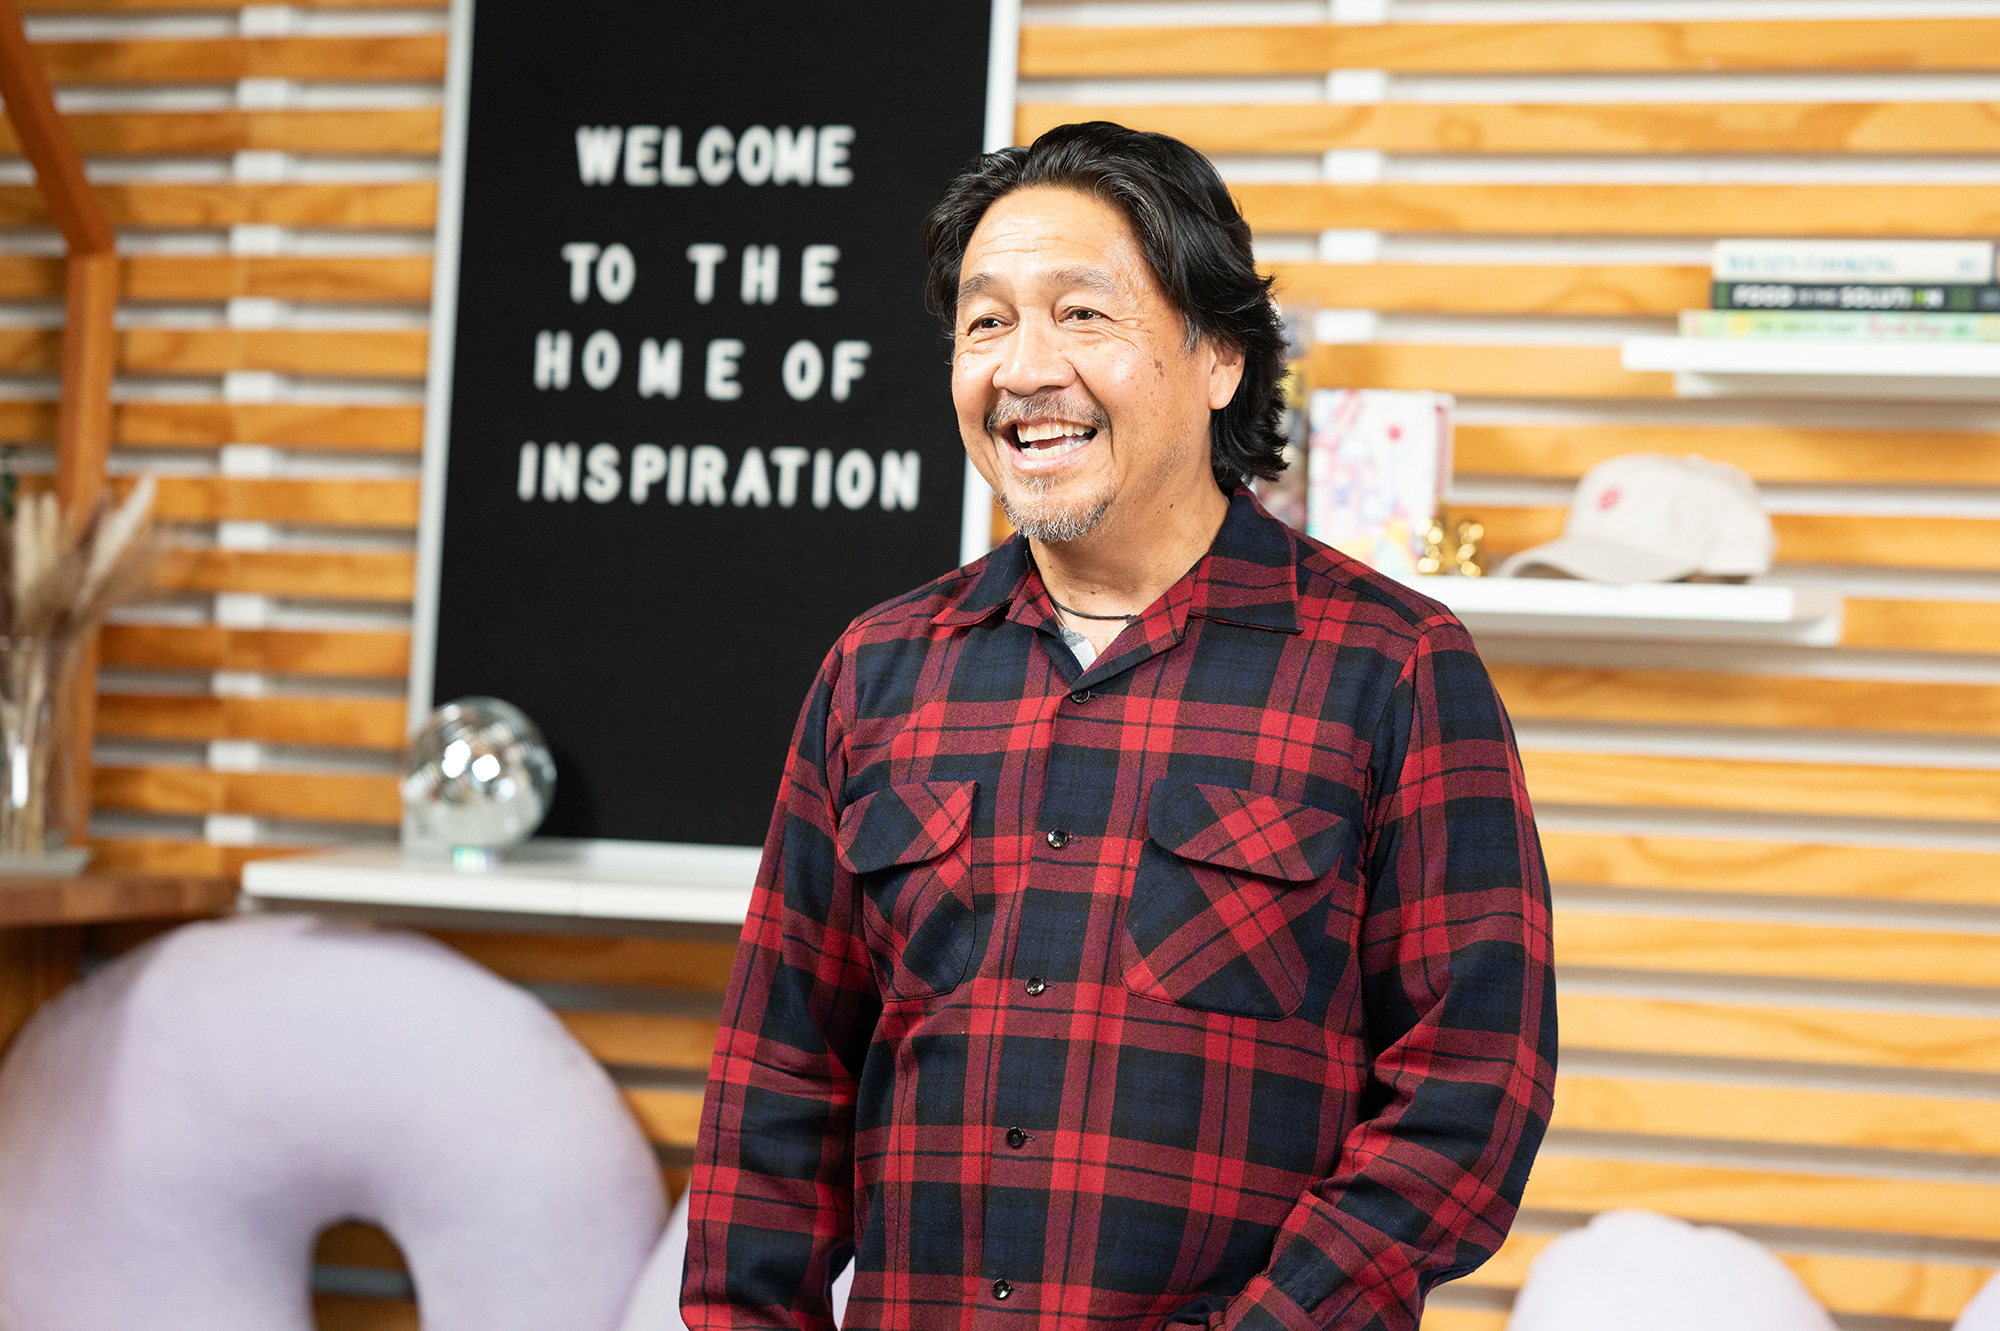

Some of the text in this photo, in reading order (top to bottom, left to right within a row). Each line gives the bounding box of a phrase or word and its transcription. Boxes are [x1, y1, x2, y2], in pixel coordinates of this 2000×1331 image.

[576, 126, 855, 186] WELCOME
[563, 243, 840, 306] TO THE
[534, 331, 871, 401] HOME OF
[518, 443, 921, 510] INSPIRATION
